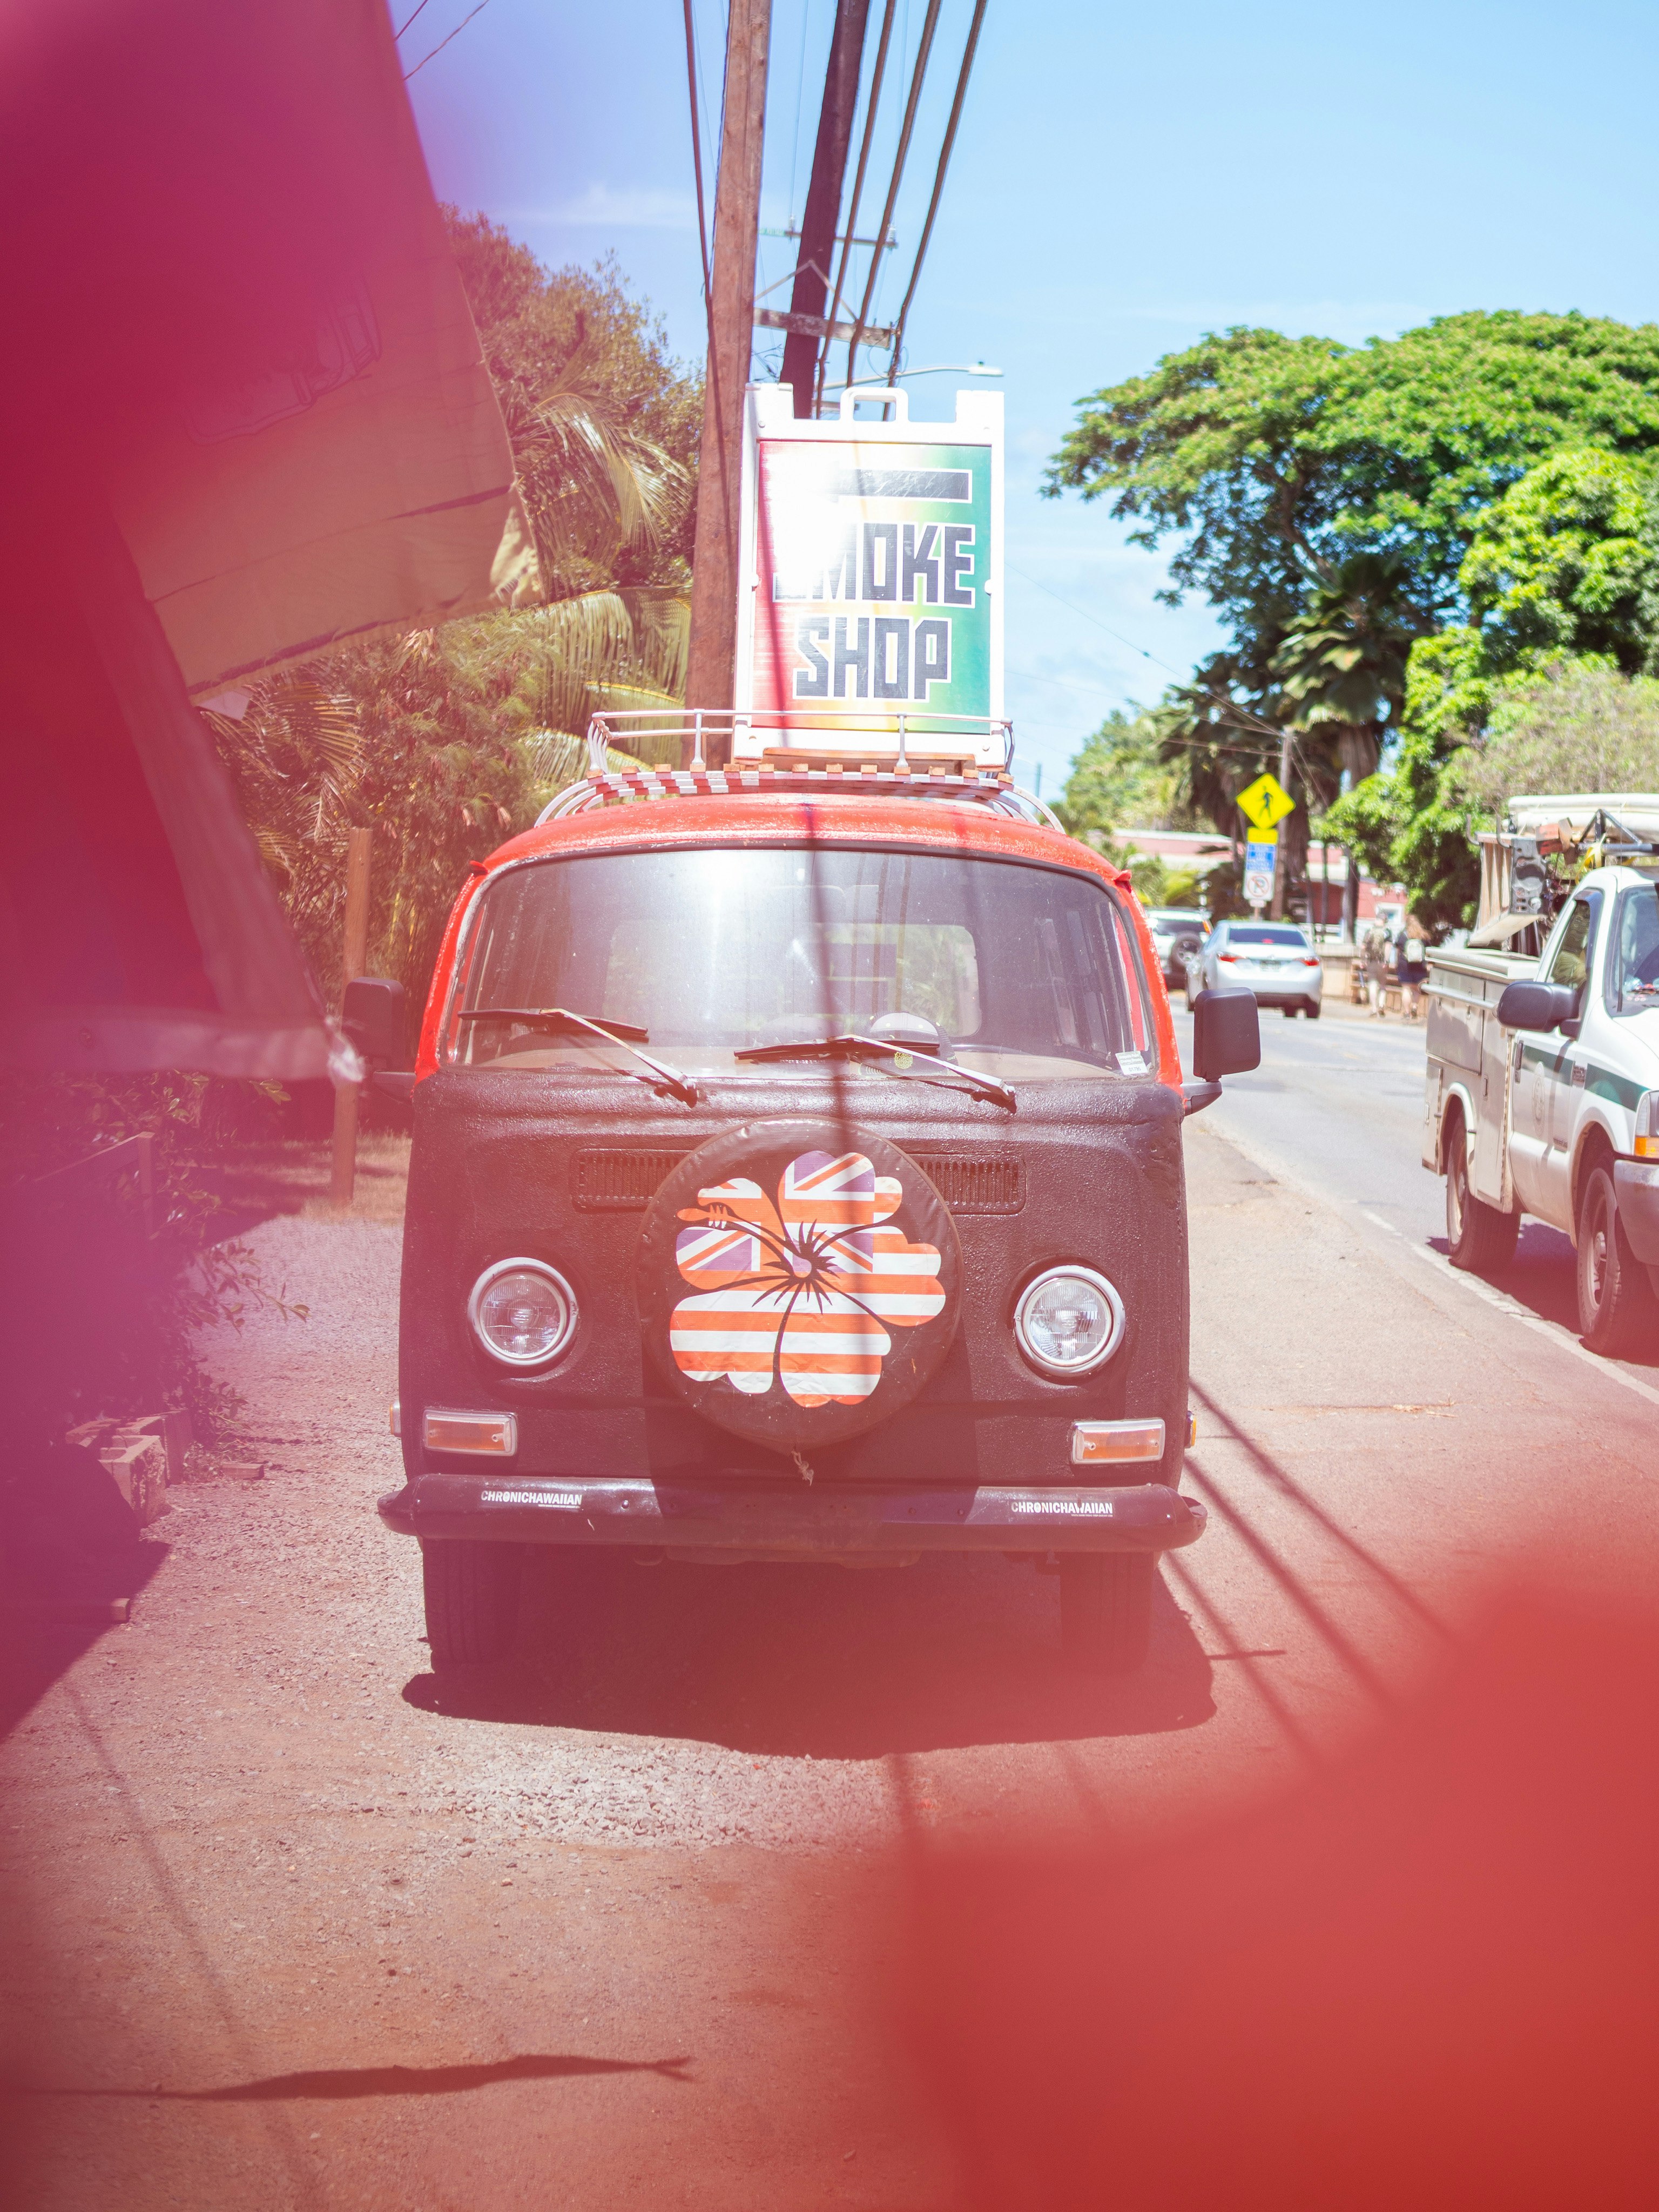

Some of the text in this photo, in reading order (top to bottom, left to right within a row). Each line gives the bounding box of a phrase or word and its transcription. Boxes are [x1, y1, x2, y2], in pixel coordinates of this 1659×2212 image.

[774, 522, 974, 606] MOKE
[794, 616, 950, 701] SHOP
[481, 1491, 582, 1505] CHRONICHAWAIIAN
[1011, 1502, 1112, 1513] CHRONICHAWAIIAN
